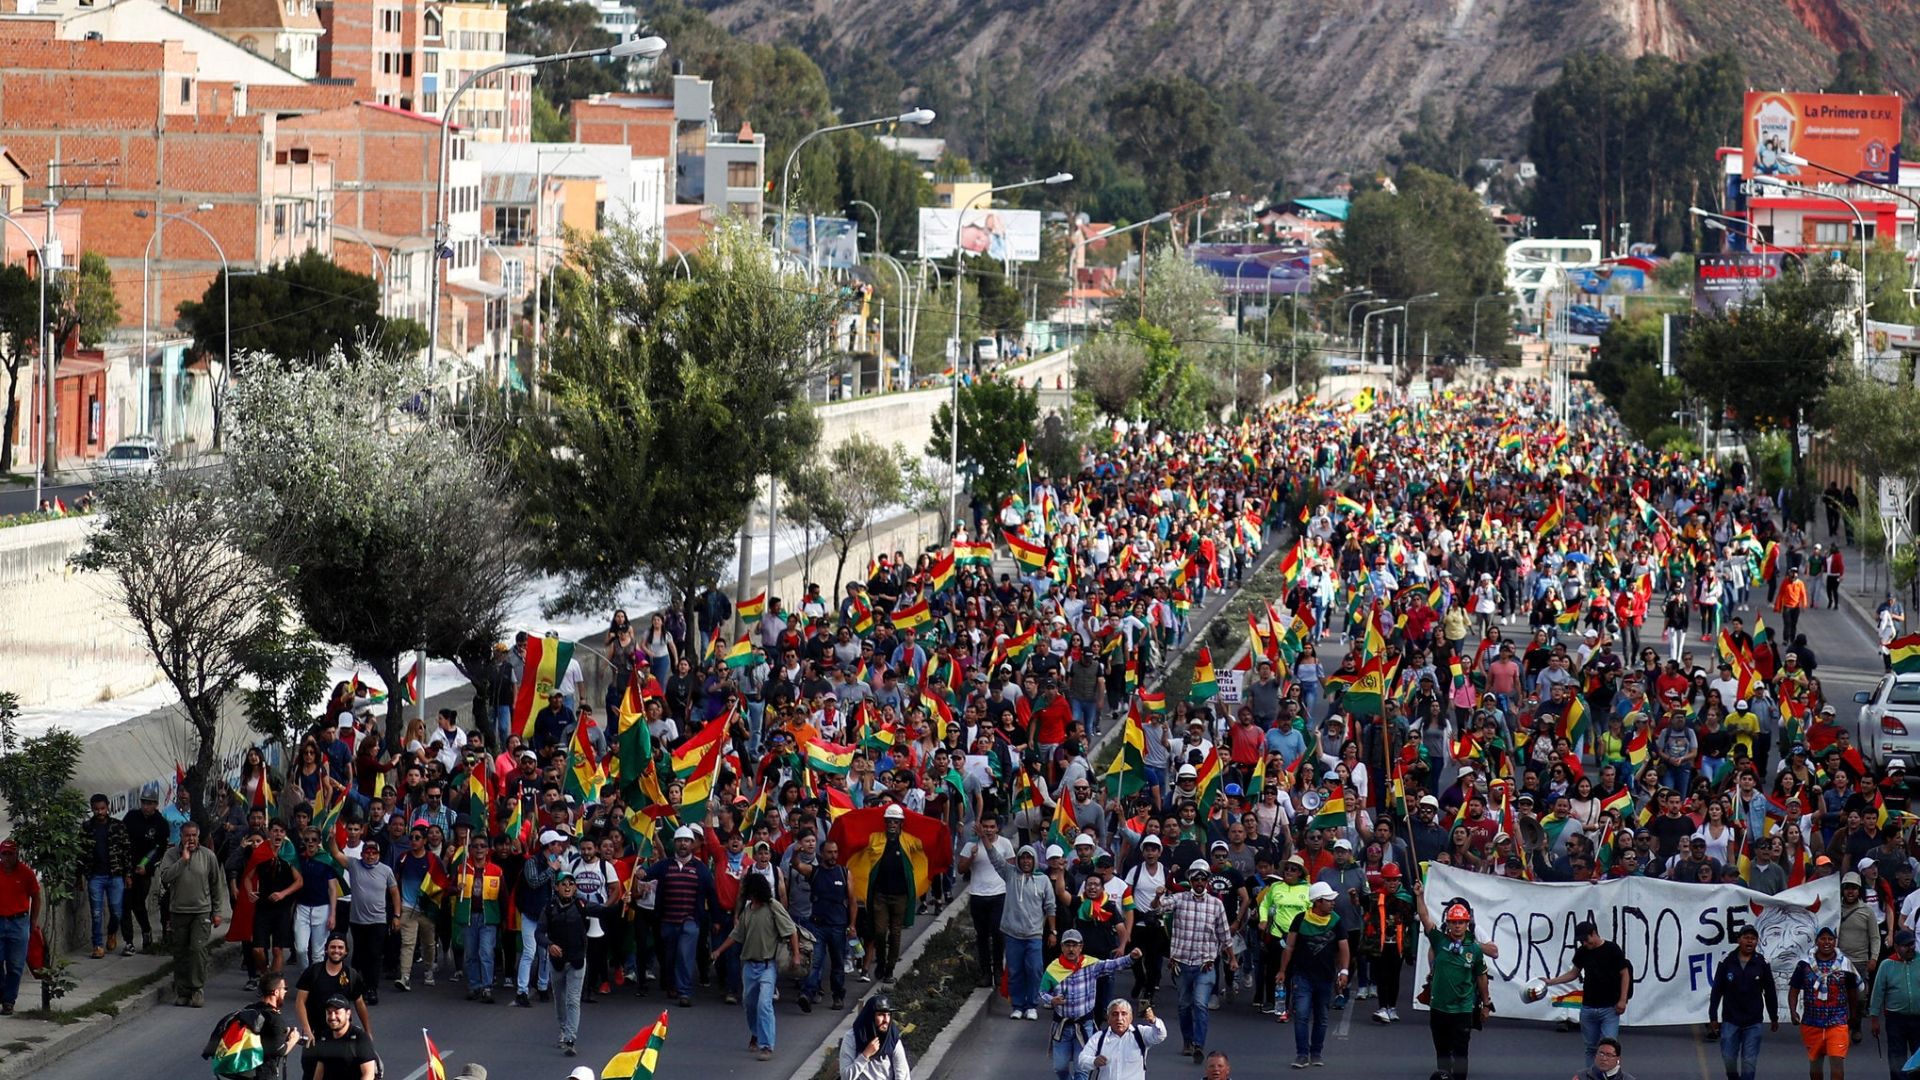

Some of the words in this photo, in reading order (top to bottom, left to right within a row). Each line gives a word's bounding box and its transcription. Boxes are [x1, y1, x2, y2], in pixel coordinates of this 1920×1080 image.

[1804, 105, 1818, 118] La
[1821, 105, 1868, 119] Primera
[1699, 265, 1777, 279] RAMBO
[1488, 905, 1682, 984] ORANDO
[1695, 905, 1750, 946] SE
